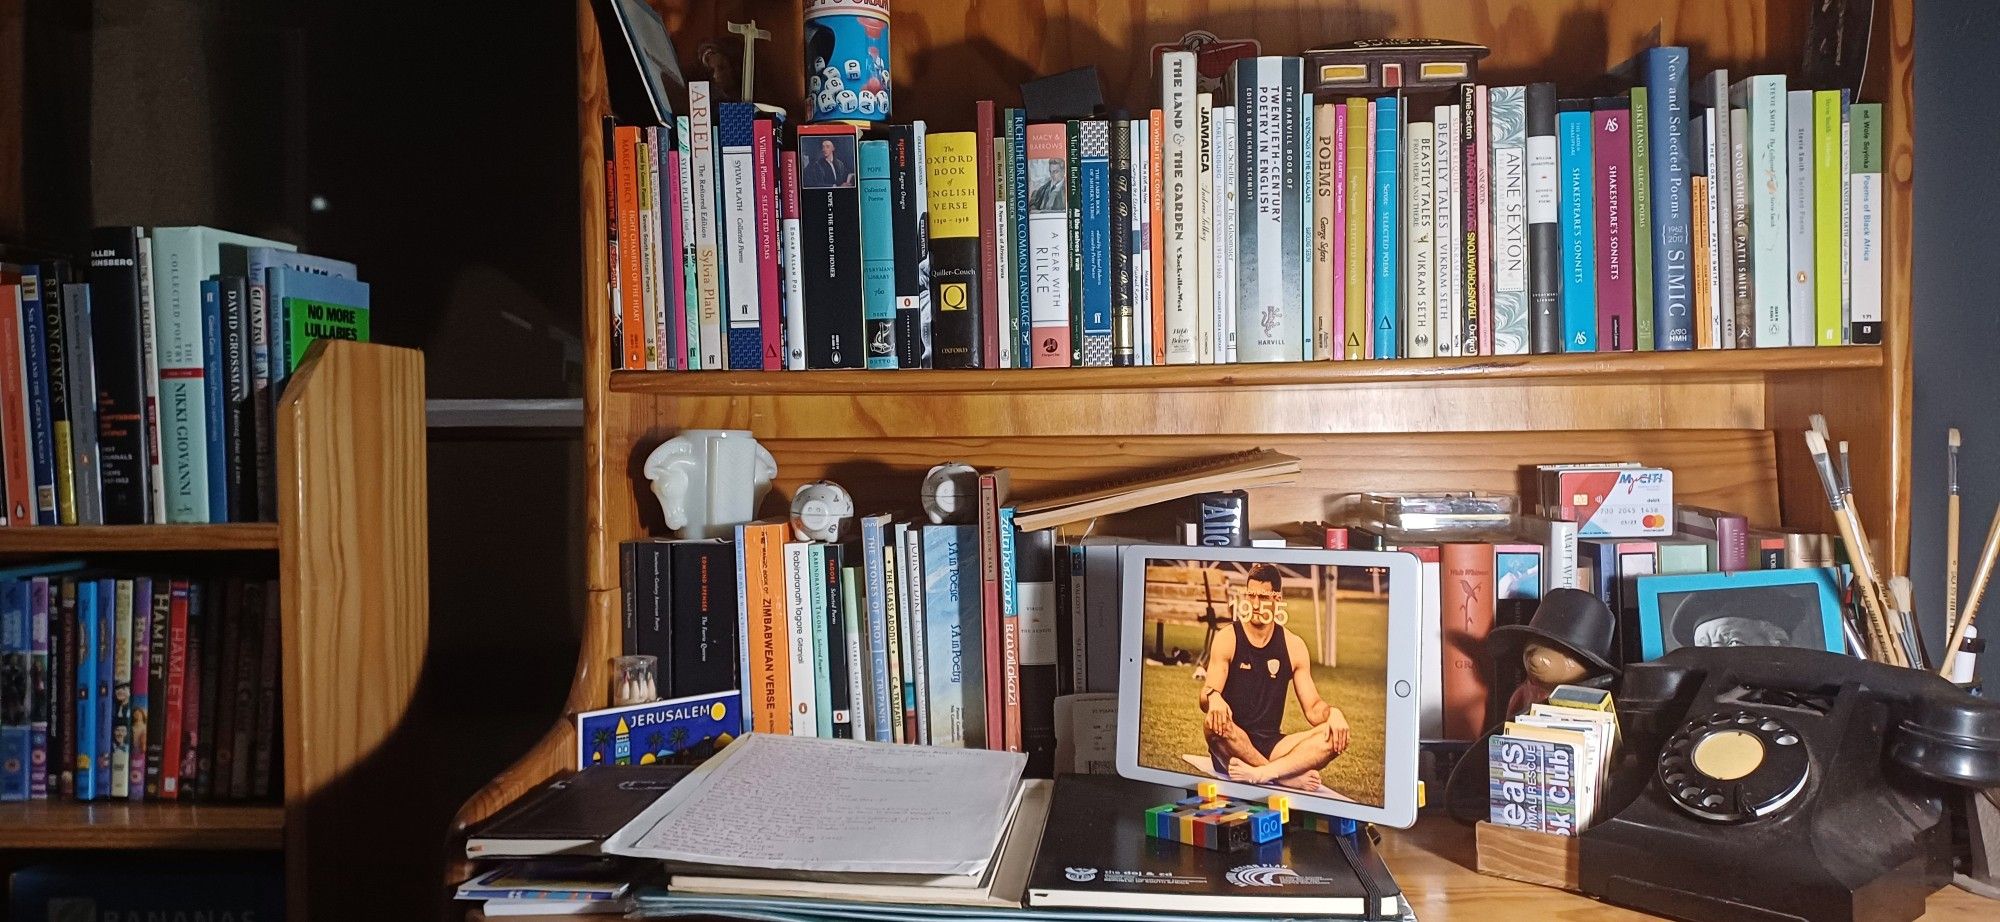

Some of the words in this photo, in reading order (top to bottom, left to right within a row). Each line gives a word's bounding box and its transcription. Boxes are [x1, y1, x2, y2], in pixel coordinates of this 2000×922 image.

[1174, 59, 1183, 87] THE
[1668, 56, 1680, 83] New
[1174, 92, 1183, 129] LAND
[1260, 86, 1269, 135] POETRY
[1465, 87, 1474, 109] Anne
[1669, 88, 1680, 111] and
[692, 90, 709, 158] ARIEL
[1015, 116, 1024, 140] RICH
[1154, 116, 1160, 127] TO
[1246, 118, 1253, 127] BY
[1466, 110, 1475, 139] Sexton
[1636, 105, 1644, 158] SIKELIANOS
[758, 136, 768, 163] William
[1015, 143, 1024, 160] THE
[1174, 132, 1186, 147] &
[1200, 107, 1210, 173] JAMAICA
[1260, 140, 1268, 153] IN
[1272, 86, 1281, 222] TWENTIETH-CENTURY
[1438, 123, 1449, 182] BEASTLY
[1669, 116, 1681, 170] Selected
[927, 156, 973, 165] OXFORD
[1174, 150, 1183, 178] THE
[1320, 136, 1331, 196] POEMS
[1421, 138, 1431, 188] BEASTLY
[1862, 143, 1870, 169] Soyinka
[734, 160, 742, 186] SYLVIA
[760, 166, 768, 190] Plomer
[934, 168, 965, 176] BOOK
[1016, 162, 1025, 198] DREAM
[1260, 159, 1269, 213] ENGLISH
[1287, 178, 1293, 189] OF
[1466, 144, 1476, 231] TRANSFORMATIONS
[1506, 154, 1521, 197] ANNE
[1736, 144, 1747, 228] WOOLGATHERING
[929, 189, 975, 198] ENGLISH
[934, 202, 968, 210] VERSE
[1017, 200, 1026, 213] OF
[1438, 188, 1448, 229] TALES
[1573, 168, 1581, 239] SHAKESPEARE'S
[1609, 166, 1617, 234] SHAKESPEARE'S
[1670, 178, 1682, 219] Poems
[1863, 203, 1870, 213] of
[1018, 214, 1026, 222] A
[1174, 183, 1184, 241] GARDEN
[1421, 193, 1431, 227] TALES
[1863, 215, 1871, 236] Black
[736, 217, 745, 243] Collected
[1052, 232, 1060, 240] A
[1507, 204, 1521, 272] SEXTON
[1668, 235, 1683, 243] 2012
[91, 259, 133, 267] GINSBERG
[829, 245, 835, 254] OF
[1018, 223, 1028, 272] COMMON
[1052, 245, 1060, 271] YEAR
[1574, 240, 1583, 284] SONNETS
[1610, 236, 1618, 280] SONNETS
[1738, 236, 1747, 265] PATTI
[632, 273, 639, 282] OF
[701, 249, 713, 284] Sylvia
[931, 269, 976, 278] Quiller-Couch
[1036, 248, 1050, 293] RILKE
[1418, 252, 1427, 296] VIKRAM
[1439, 244, 1448, 287] VIKRAM
[1468, 233, 1478, 320] TRANSFORMATIONS
[943, 285, 965, 309] Q
[1053, 277, 1061, 306] WITH
[1668, 250, 1686, 317] SIMIC
[1739, 268, 1748, 299] SMITH
[229, 291, 240, 328] DAVID
[308, 304, 323, 320] NO
[326, 307, 356, 324] MORE
[704, 288, 714, 319] Plath
[1019, 275, 1030, 326] LANGUAGE
[1418, 302, 1427, 327] SETH
[1440, 293, 1448, 319] SETH
[1468, 324, 1478, 353] Oxford
[231, 333, 242, 401] GROSSMAN
[175, 383, 185, 421] NIKKI
[176, 426, 191, 496] GIOVANNI
[868, 536, 876, 554] THE
[950, 556, 959, 565] in
[793, 551, 804, 605] Rabindranath
[950, 568, 960, 602] Poesie
[794, 607, 805, 634] Tagore
[873, 602, 879, 613] OF
[153, 593, 169, 679] HAMLET
[764, 598, 774, 671] ZIMBABWEAN
[873, 620, 881, 645] TROY
[953, 640, 961, 648] in
[169, 628, 183, 711] HAMLET
[952, 650, 963, 683] Poetry
[766, 675, 777, 709] VERSE
[630, 704, 710, 727] JERUSALEM
[1526, 745, 1537, 792] RESCUE
[1549, 750, 1571, 804] club
[1502, 744, 1526, 826] ears
